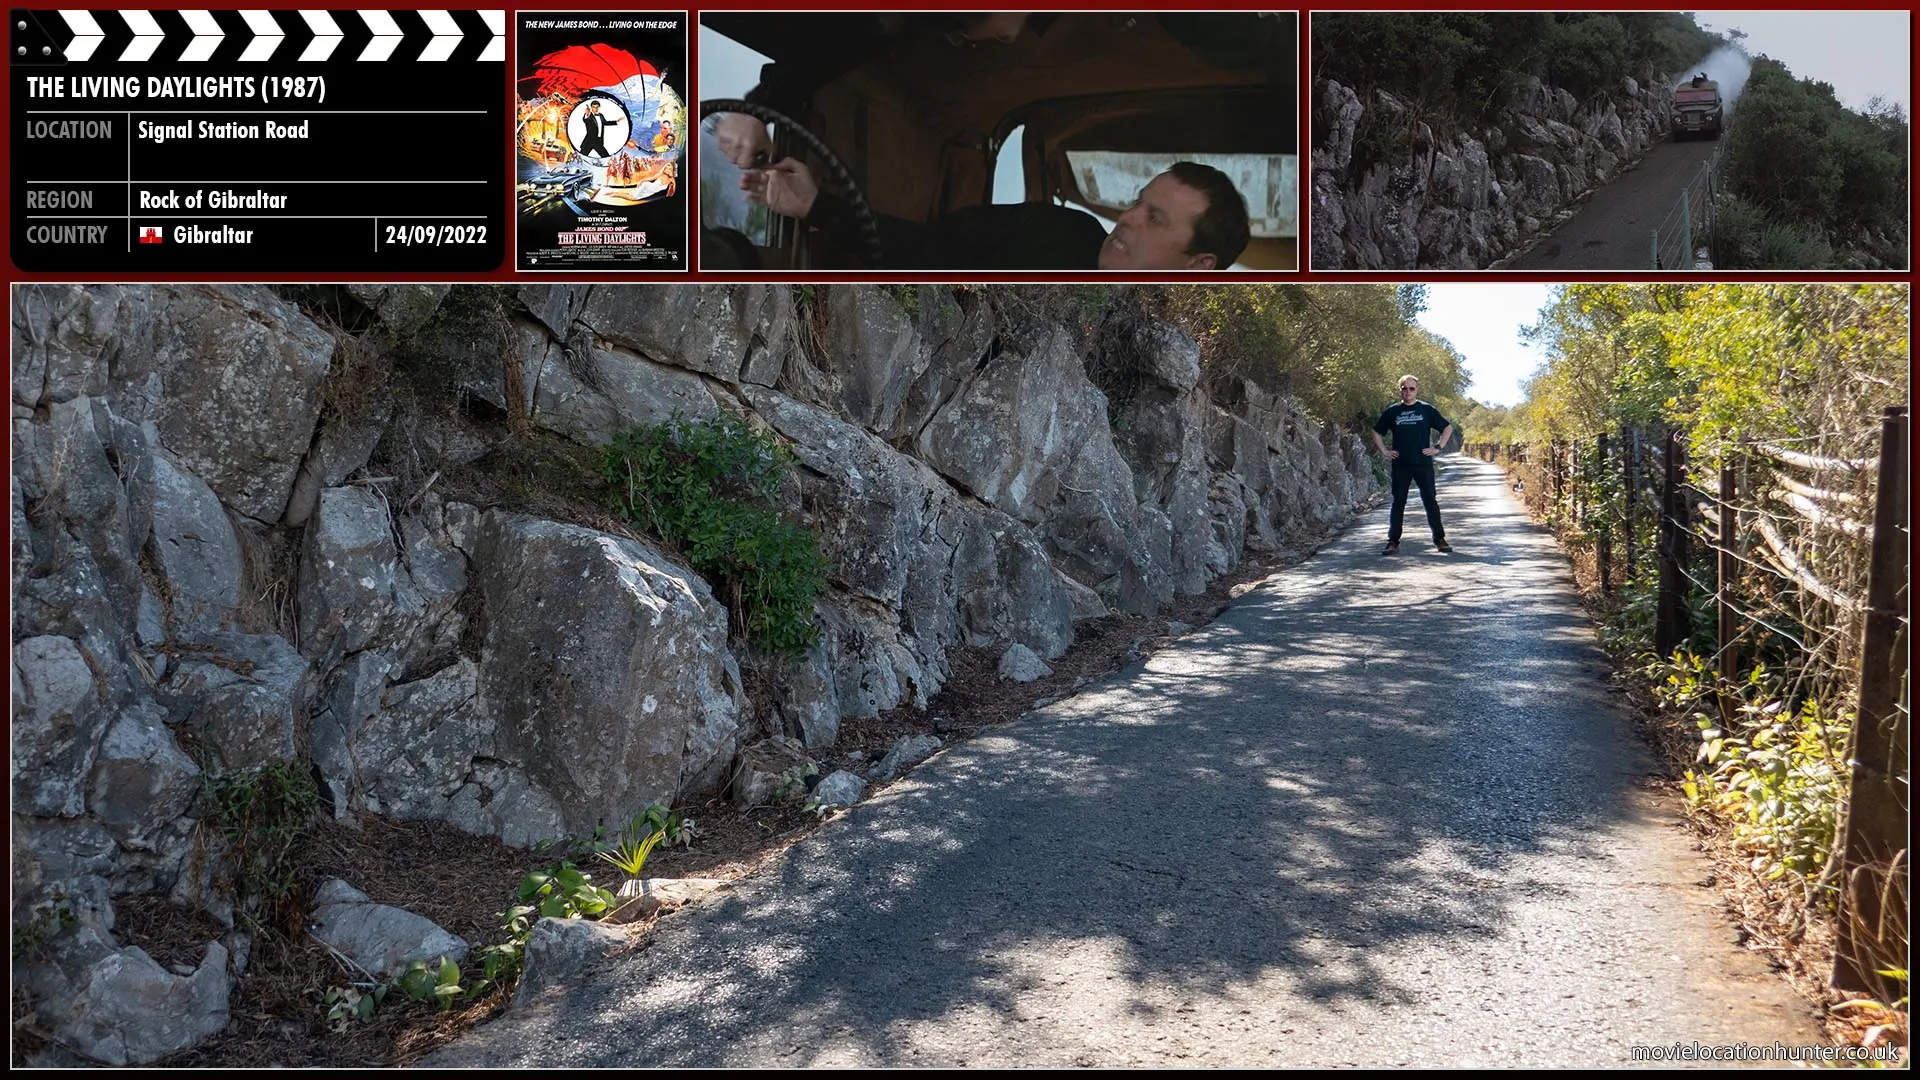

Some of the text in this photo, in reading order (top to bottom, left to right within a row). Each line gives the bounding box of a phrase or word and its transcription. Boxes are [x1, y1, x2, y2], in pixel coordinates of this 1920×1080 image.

[525, 20, 539, 29] THE
[537, 20, 555, 29] NEW
[554, 20, 578, 29] JAMES
[577, 20, 599, 29] BOND
[608, 20, 633, 29] LIVING
[632, 20, 645, 29] ON
[645, 20, 659, 29] THE
[657, 20, 678, 29] EDGE
[557, 232, 647, 244] THE LIVING DAYLIGHTS
